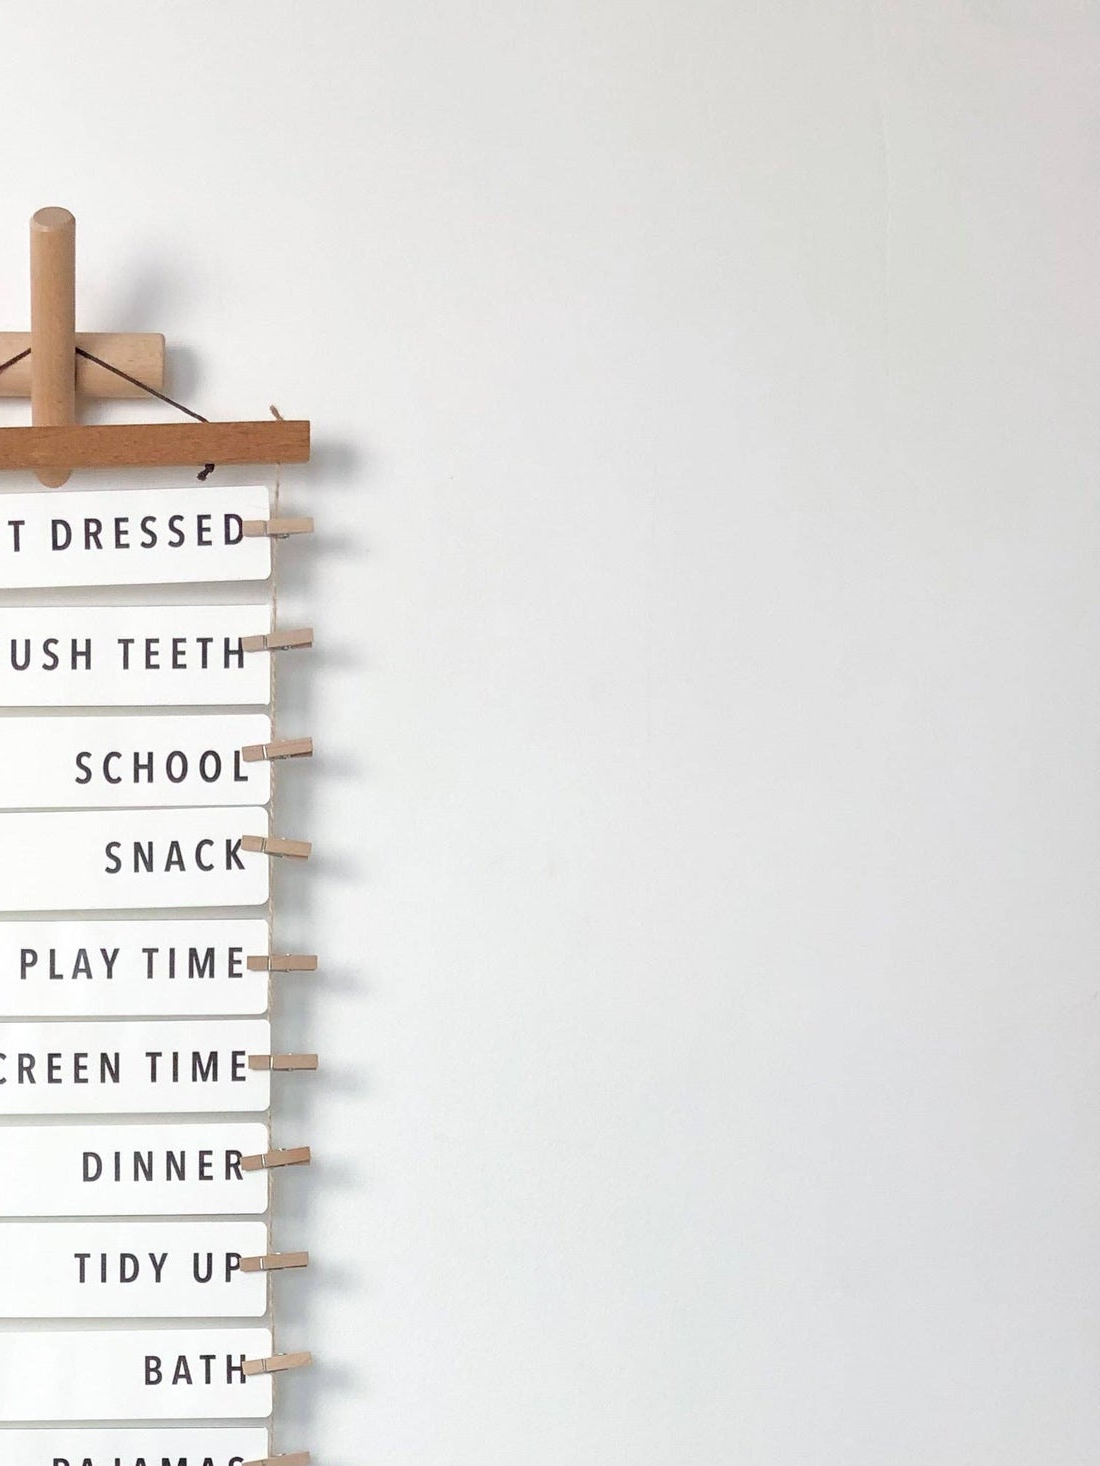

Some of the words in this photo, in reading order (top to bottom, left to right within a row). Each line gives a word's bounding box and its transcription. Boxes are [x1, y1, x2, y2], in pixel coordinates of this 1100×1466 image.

[51, 513, 244, 551] DRESSED
[117, 637, 244, 670] TEETH
[75, 750, 249, 785] SCHOOL
[105, 838, 246, 873] SNACK
[20, 948, 120, 980] PLAY
[142, 947, 243, 979] TIME
[145, 1050, 246, 1083] TIME
[82, 1149, 243, 1182] DINNER
[74, 1252, 168, 1283] TIDY
[193, 1252, 242, 1284] UP
[144, 1354, 246, 1386] BATH
